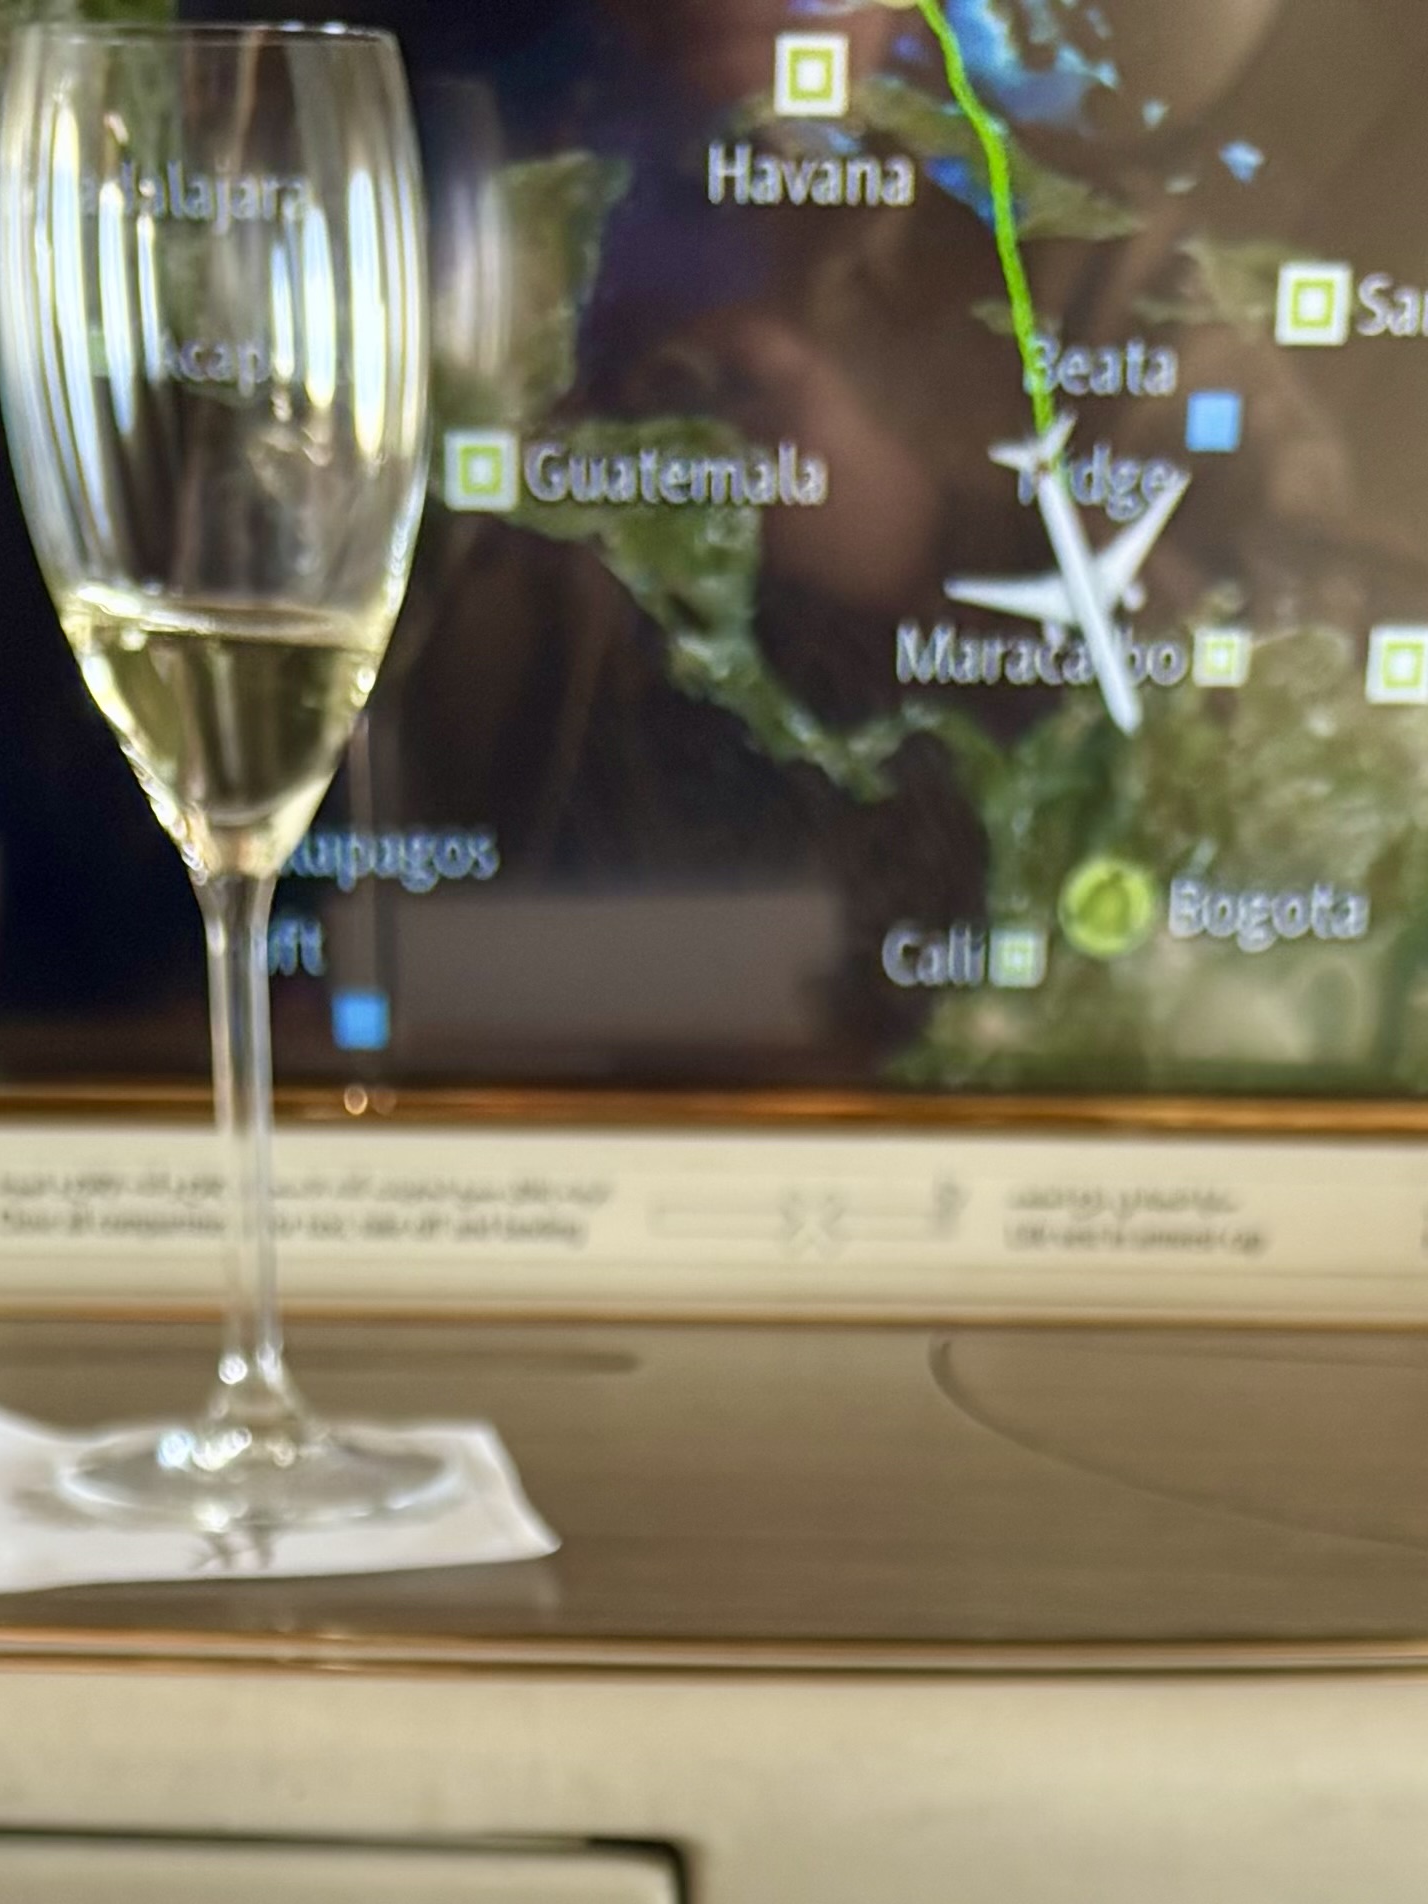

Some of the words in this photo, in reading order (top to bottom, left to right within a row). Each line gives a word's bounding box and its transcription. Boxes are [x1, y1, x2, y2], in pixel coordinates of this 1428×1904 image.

[708, 141, 916, 208] Havana
[1024, 335, 1178, 397] Beata
[524, 440, 828, 506] Guatemala
[895, 622, 1187, 687] Maracabo
[1168, 876, 1369, 954] Bogota
